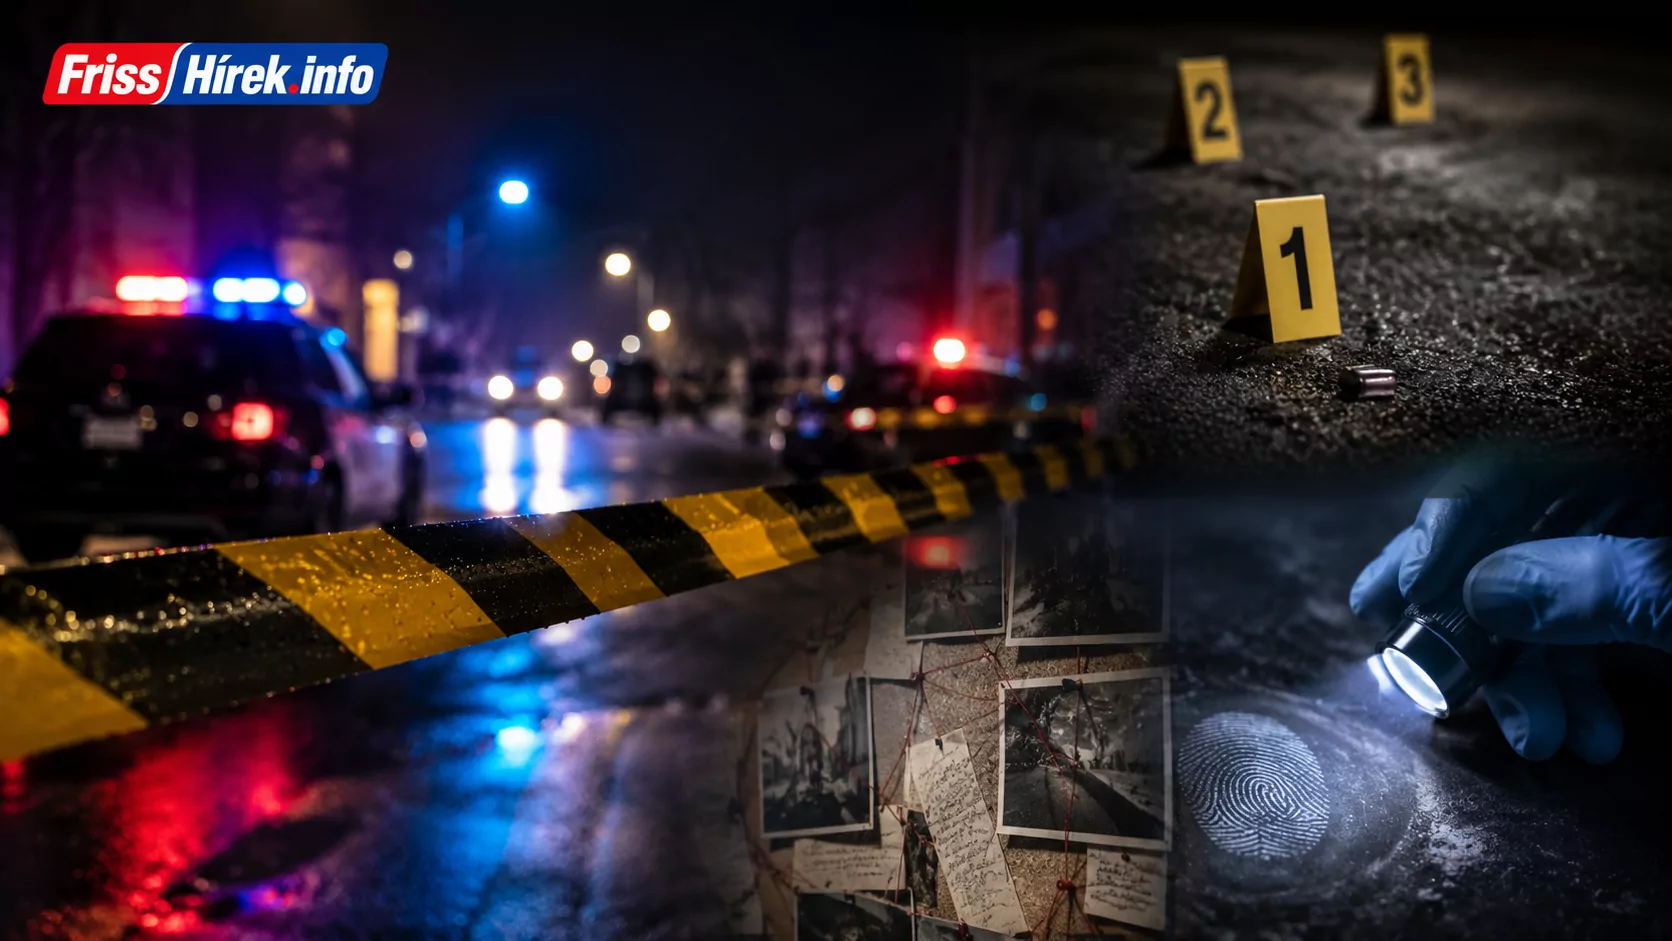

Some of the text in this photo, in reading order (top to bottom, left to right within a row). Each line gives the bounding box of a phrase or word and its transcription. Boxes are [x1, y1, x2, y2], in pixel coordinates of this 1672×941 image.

[1195, 79, 1230, 141] 2
[1396, 53, 1424, 106] 3
[1279, 226, 1313, 311] 1
